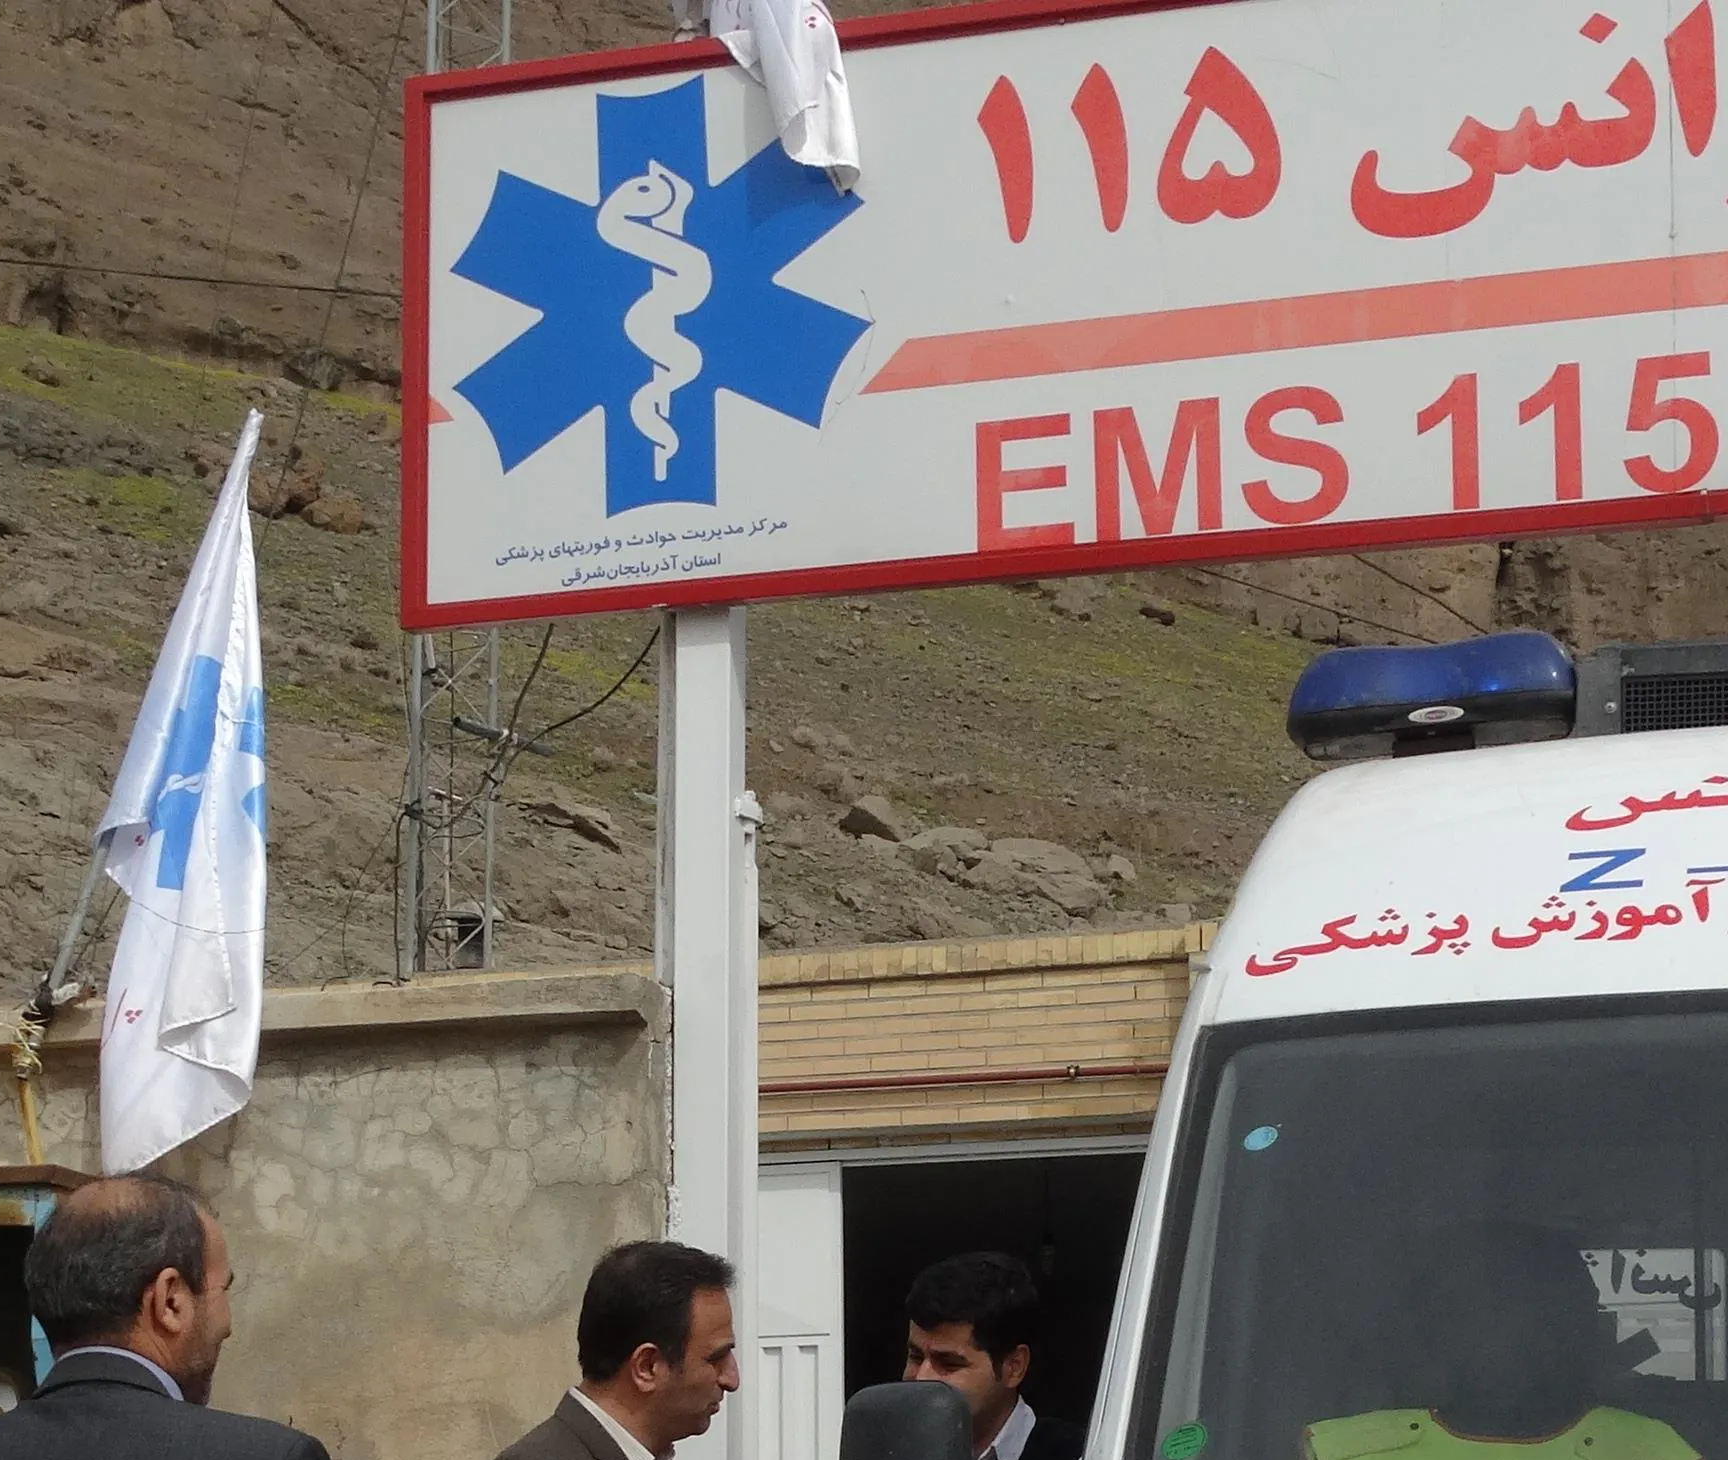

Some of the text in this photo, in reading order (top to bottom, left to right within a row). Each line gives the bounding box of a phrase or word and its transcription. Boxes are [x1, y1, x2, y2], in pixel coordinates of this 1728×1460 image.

[977, 48, 1281, 243] ۱۱۵
[975, 350, 1720, 551] EMS 115
[681, 524, 744, 542] مدیریت
[748, 517, 788, 537] مرکز
[626, 529, 676, 548] حوادث
[495, 547, 545, 566] پزشکی
[682, 553, 722, 572] استان
[1490, 878, 1728, 950] آموزش
[1245, 904, 1470, 978] پزشکی
